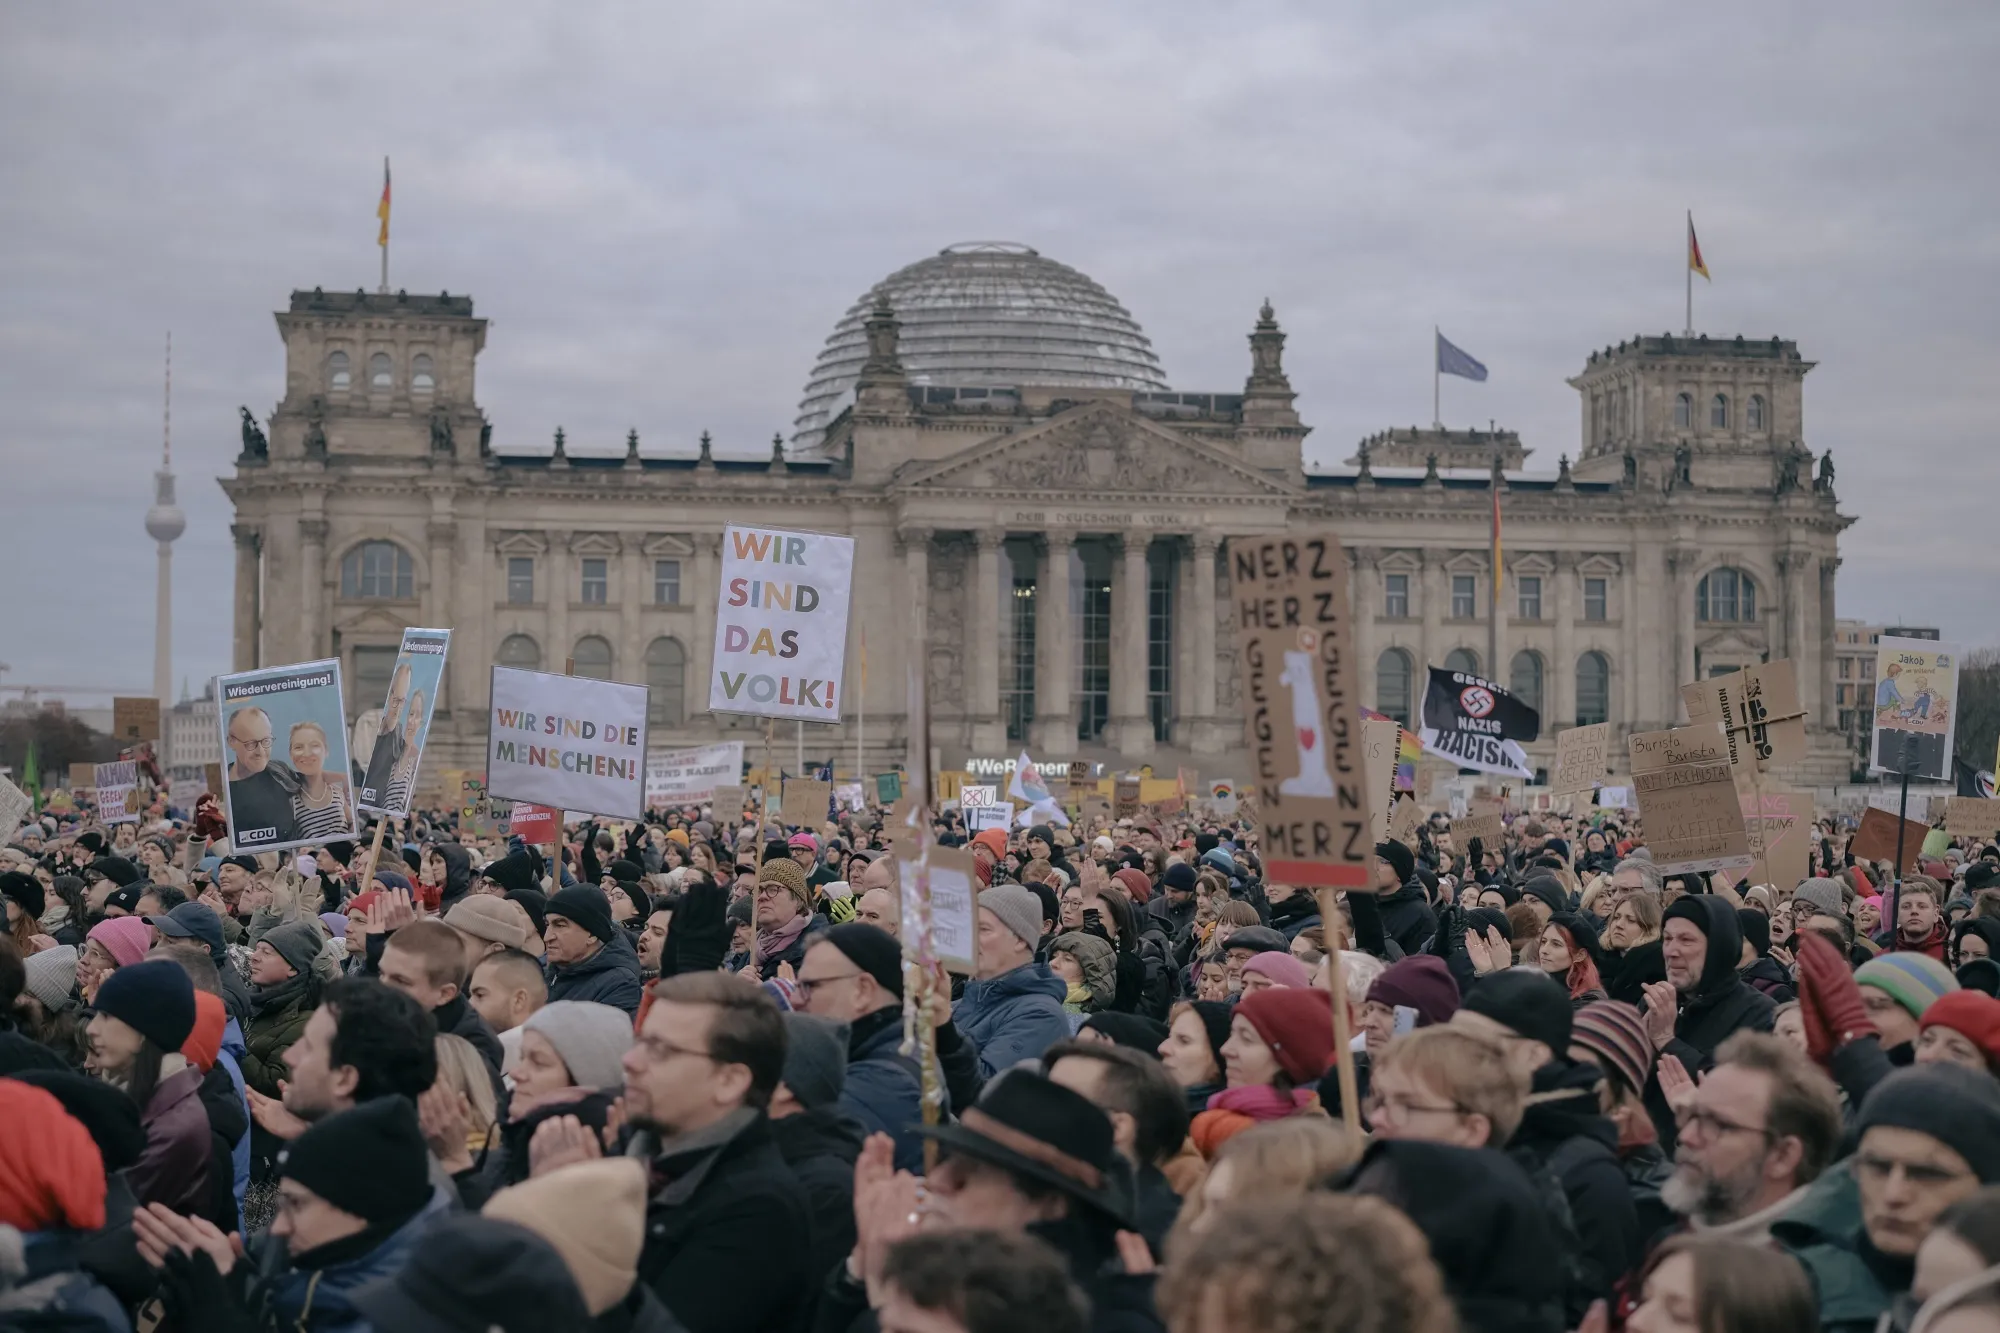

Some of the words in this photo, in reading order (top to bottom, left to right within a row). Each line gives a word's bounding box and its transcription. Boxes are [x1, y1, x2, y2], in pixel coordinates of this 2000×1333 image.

[1016, 511, 1045, 522] DEM
[1056, 512, 1132, 524] DEUTSCHEN
[732, 531, 807, 567] WIR
[1236, 540, 1334, 583] NERZ
[728, 577, 820, 613] SIND
[1240, 592, 1337, 630] HERZ
[724, 624, 799, 659] DAS
[1898, 653, 1925, 666] Jakob
[227, 673, 331, 698] Wiedervereinigung!
[719, 670, 835, 710] VOLK!
[496, 707, 537, 732] WIR
[544, 715, 597, 741] SIND
[603, 723, 638, 746] DIE
[1246, 637, 1280, 808] GEGEN
[1320, 630, 1361, 811] GEGEN
[1457, 716, 1502, 735] NAZIS
[495, 740, 636, 781] MENSCHEN!
[1559, 762, 1604, 783] RECHTS
[1663, 746, 1717, 764] Barista
[475, 802, 488, 815] ist
[249, 828, 275, 841] CDU
[1266, 821, 1366, 863] MERZ
